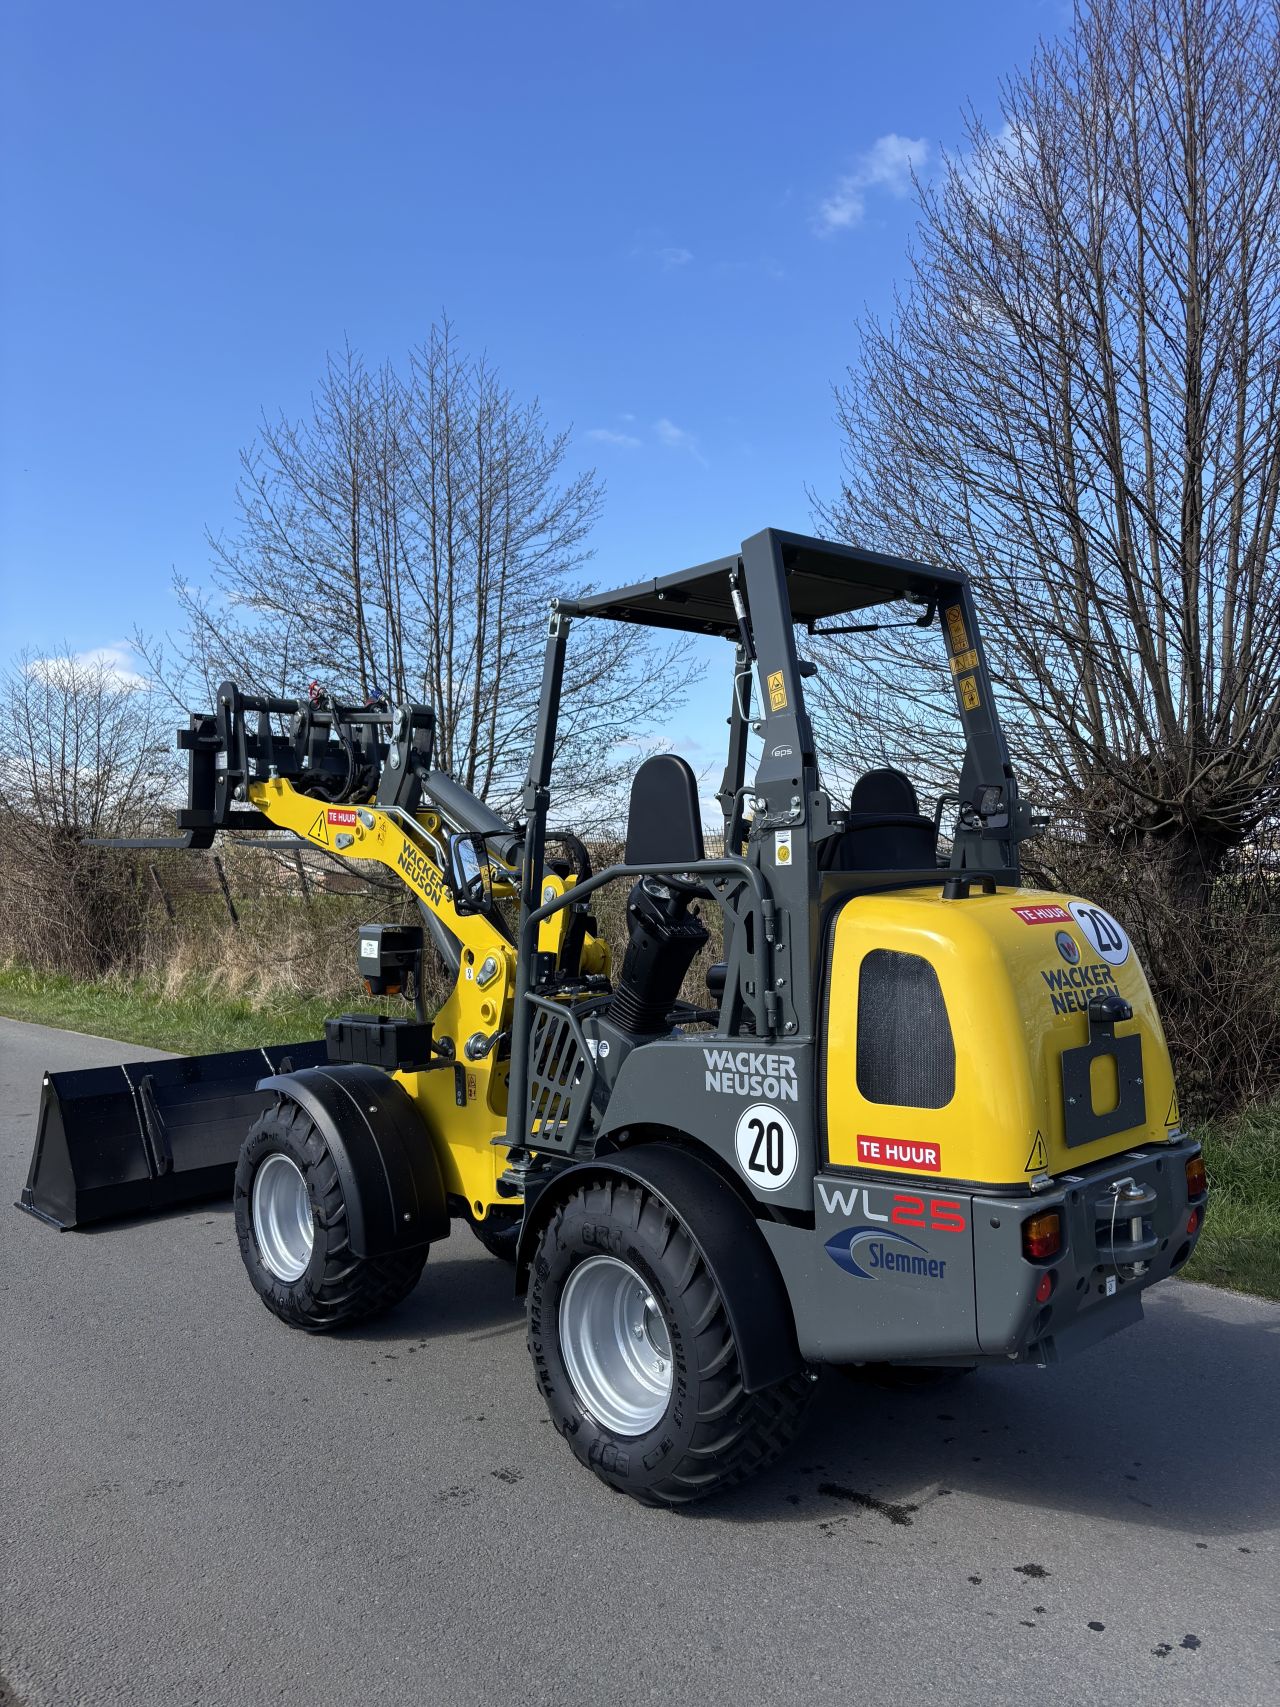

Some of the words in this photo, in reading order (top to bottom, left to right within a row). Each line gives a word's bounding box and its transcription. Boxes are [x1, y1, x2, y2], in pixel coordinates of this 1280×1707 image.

[775, 748, 792, 758] eps
[328, 811, 337, 822] TE
[338, 812, 356, 824] HUUR
[397, 852, 441, 907] NEUSON
[403, 838, 444, 895] WACKER
[1017, 909, 1036, 921] TE
[1035, 906, 1068, 918] HUUR
[1077, 908, 1123, 952] 20
[1041, 963, 1116, 991] WACKER
[703, 1048, 798, 1078] WACKER
[705, 1070, 799, 1102] NEUSON
[747, 1118, 784, 1176] 20
[860, 1141, 881, 1158] TE
[885, 1144, 937, 1165] HUUR
[817, 1183, 966, 1233] WL25
[869, 1243, 947, 1279] Slemmer
